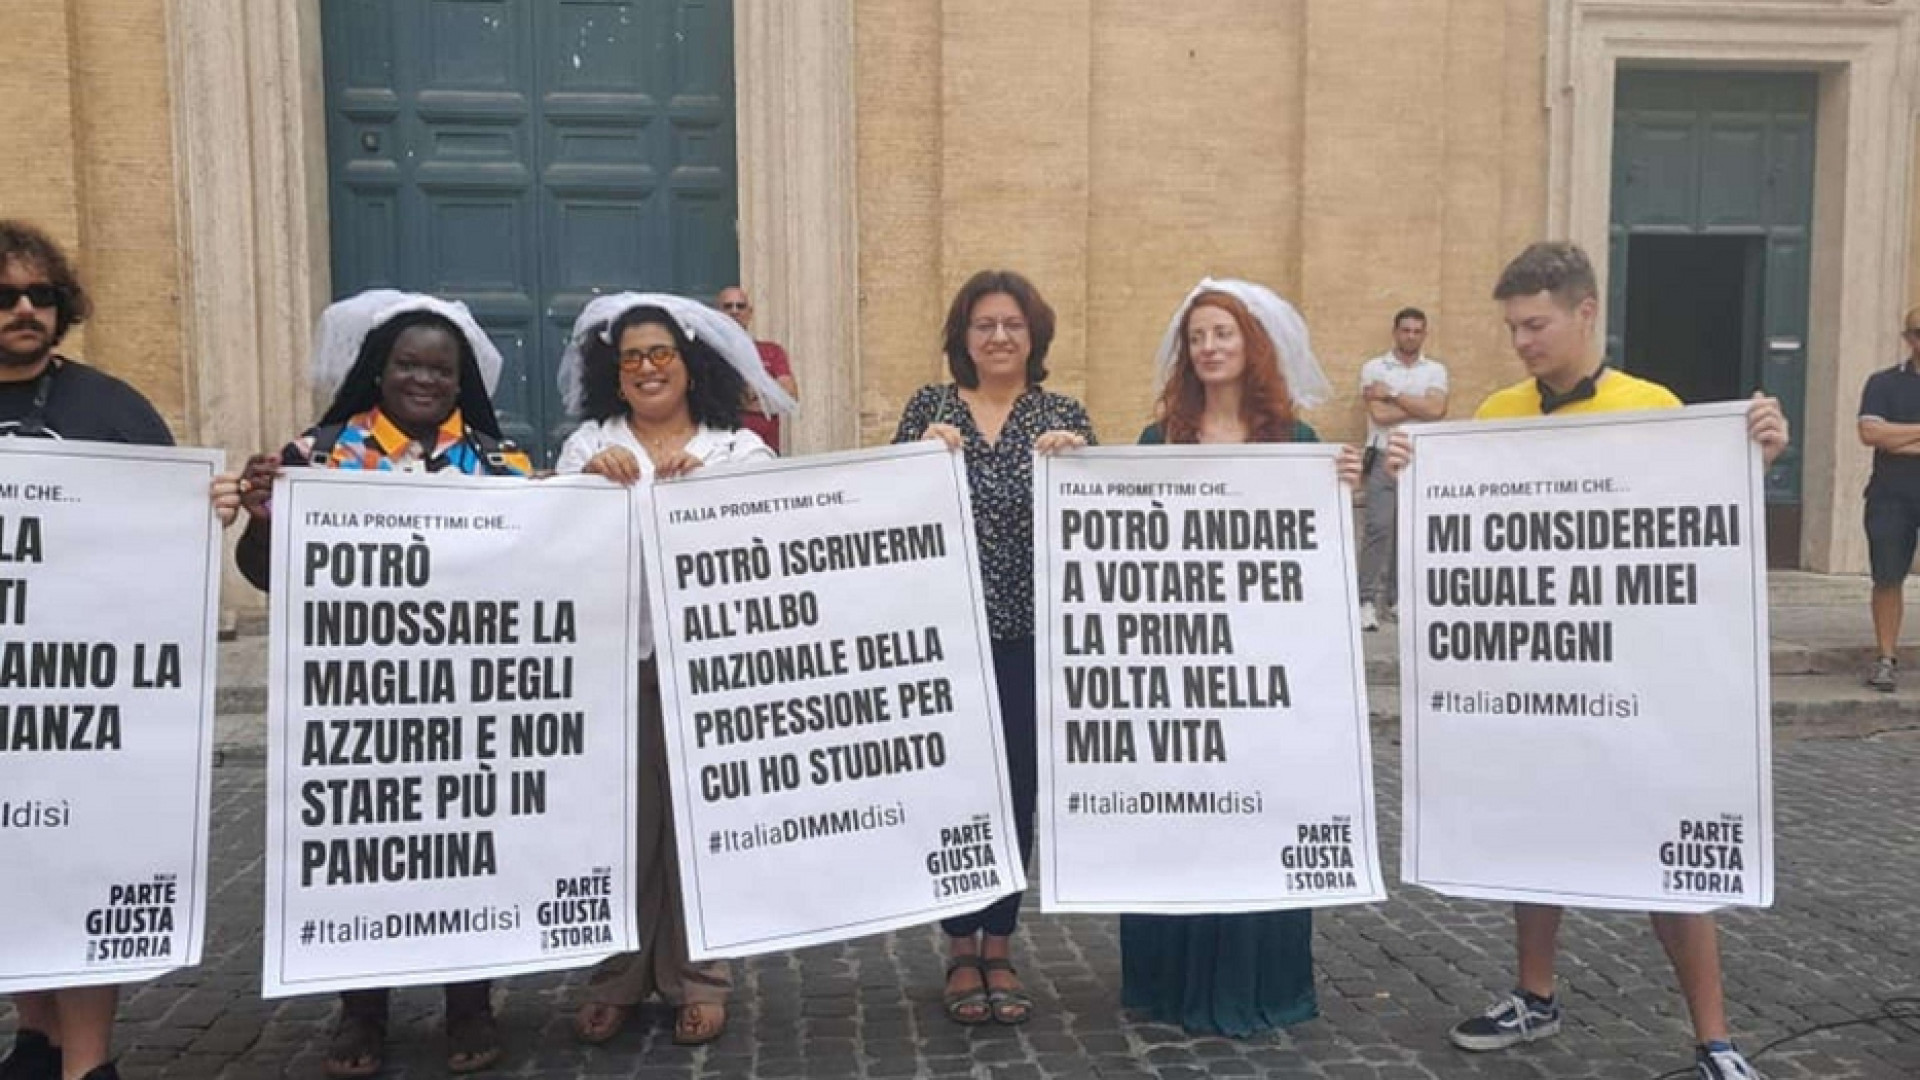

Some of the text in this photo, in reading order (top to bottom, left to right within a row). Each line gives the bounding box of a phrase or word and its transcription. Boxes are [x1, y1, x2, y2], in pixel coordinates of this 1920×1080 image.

[669, 506, 718, 524] ITALIA
[719, 495, 814, 519] PROMETTIMI
[1059, 482, 1104, 496] ITALIA
[1106, 482, 1196, 497] PROMETTIMI
[1426, 484, 1476, 500] ITALIA
[1478, 479, 1579, 497] PROMETTIMI
[306, 510, 360, 528] ITALIA
[364, 513, 469, 530] PROMETTIMI
[1061, 500, 1318, 552] POTRÒ ANDARE
[1427, 504, 1740, 554] MI CONSIDERERAI
[304, 532, 430, 588] POTRÒ
[675, 522, 946, 591] POTRÒ ISCRIVERMI
[1061, 560, 1303, 603] A VOTARE PER
[1427, 562, 1698, 607] UGUALE AI MIEI
[304, 600, 576, 646] INDOSSARE LA
[684, 591, 820, 642] ALL'ALBO
[1063, 611, 1234, 656] LA PRIMA
[688, 626, 944, 695] NAZIONALE DELLA
[1428, 621, 1612, 663] COMPAGNI
[132, 643, 181, 689] LA
[304, 656, 573, 707] MAGLIA DEGLI
[1063, 664, 1291, 710] VOLTA NELLA
[1430, 690, 1638, 718] #ItaliaDIMMIdisì
[694, 677, 954, 749] PROFESSIONE PER
[302, 711, 584, 767] AZZURRI E NON
[1065, 718, 1227, 764] MIA VITA
[701, 731, 946, 803] CUI HO STUDIATO
[301, 762, 547, 827] STARE PIÙ IN
[1069, 788, 1262, 815] #ItaliaDIMMIdisì
[708, 802, 905, 855] #ItaliaDIMMIdisì
[940, 820, 993, 849] PARTE
[1297, 822, 1352, 845] PARTE
[1678, 818, 1743, 844] PARTE
[300, 829, 497, 887] PANCHINA
[925, 842, 997, 876] GIUSTA
[1281, 844, 1354, 871] GIUSTA
[1659, 840, 1744, 871] GIUSTA
[109, 880, 177, 907] PARTE
[557, 875, 611, 900] PARTE
[940, 868, 1001, 897] STORIA
[1295, 870, 1357, 892] STORIA
[1673, 869, 1744, 894] STORIA
[86, 904, 174, 936] GIUSTA
[300, 905, 520, 946] #ItaliaDIMMIdisì
[537, 897, 611, 927] GIUSTA
[97, 934, 171, 961] STORIA
[548, 922, 613, 949] STORIA
